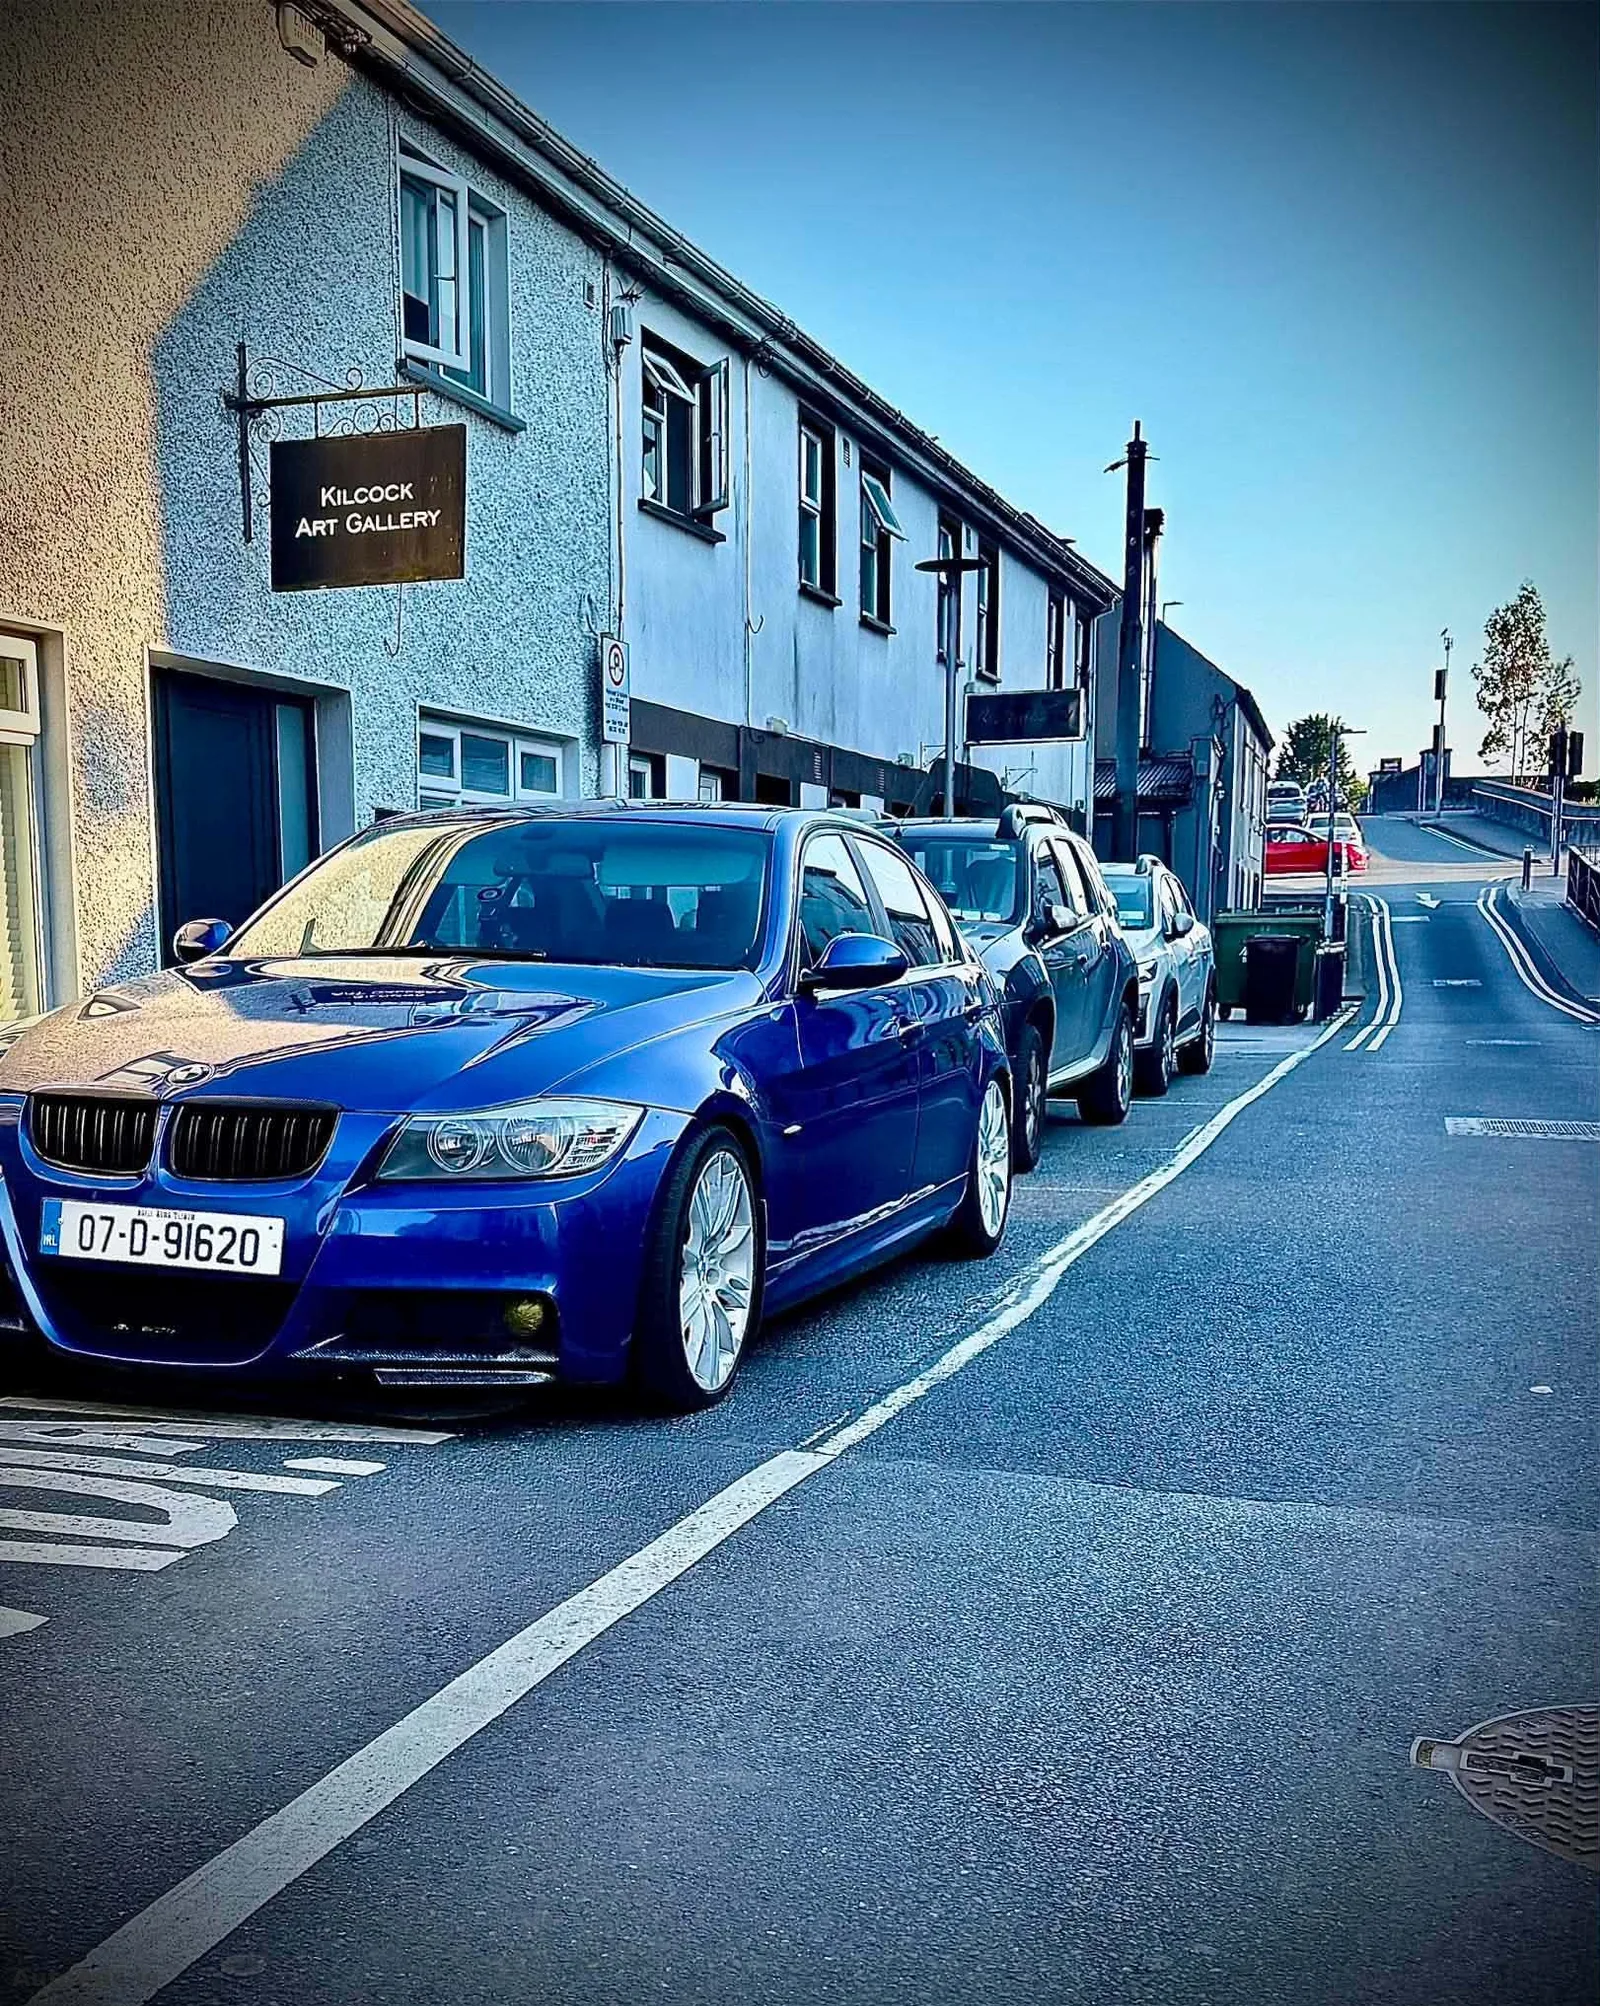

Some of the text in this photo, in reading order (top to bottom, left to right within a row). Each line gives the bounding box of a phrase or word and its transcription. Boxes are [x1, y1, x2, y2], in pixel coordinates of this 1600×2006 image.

[320, 482, 415, 508] KILCOCK
[295, 509, 442, 538] ART GALLERY
[43, 1233, 58, 1247] IRL
[78, 1214, 261, 1267] 07-D-91620
